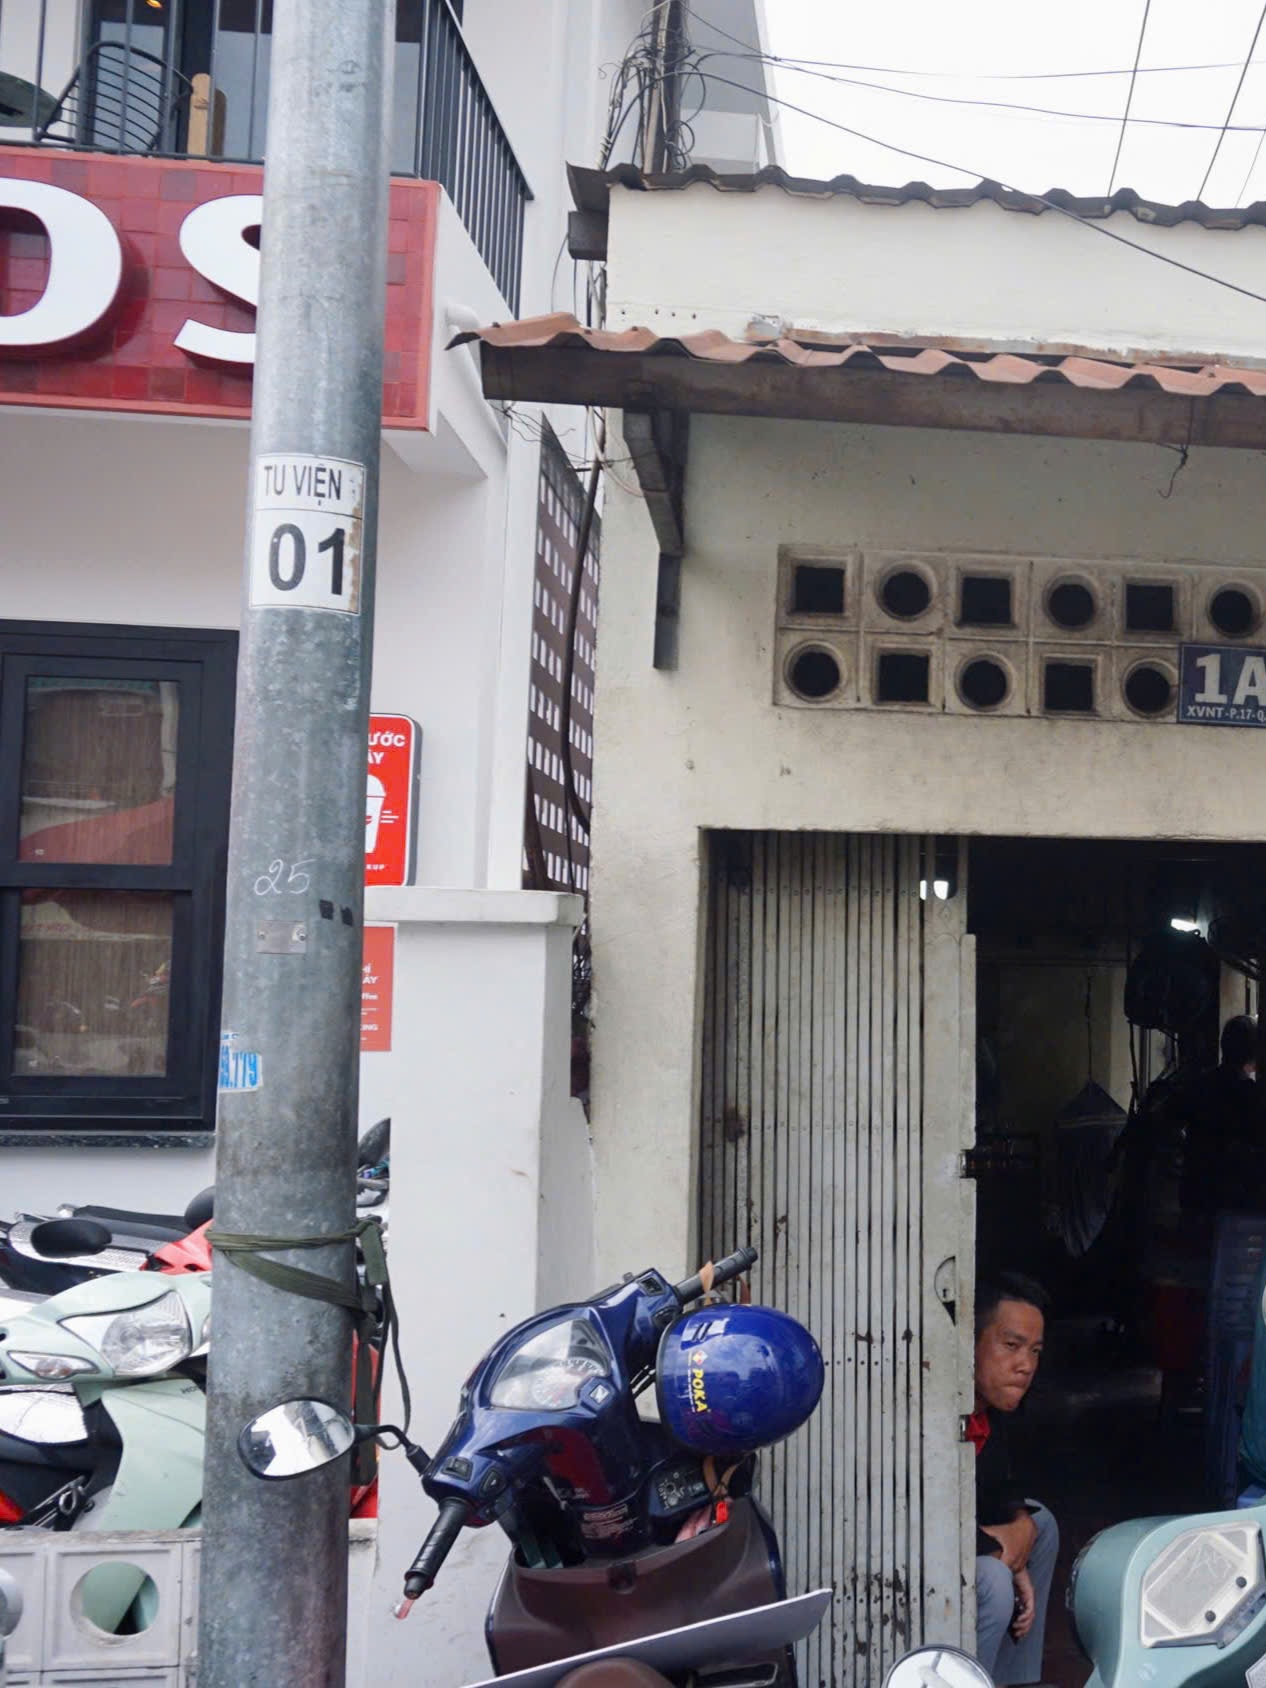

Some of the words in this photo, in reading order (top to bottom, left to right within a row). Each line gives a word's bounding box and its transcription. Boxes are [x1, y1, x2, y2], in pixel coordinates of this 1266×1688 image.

[264, 464, 286, 496] TU
[293, 463, 342, 506] VIỆN
[269, 523, 345, 596] 01
[254, 858, 317, 896] 25
[691, 1368, 708, 1412] POKA
